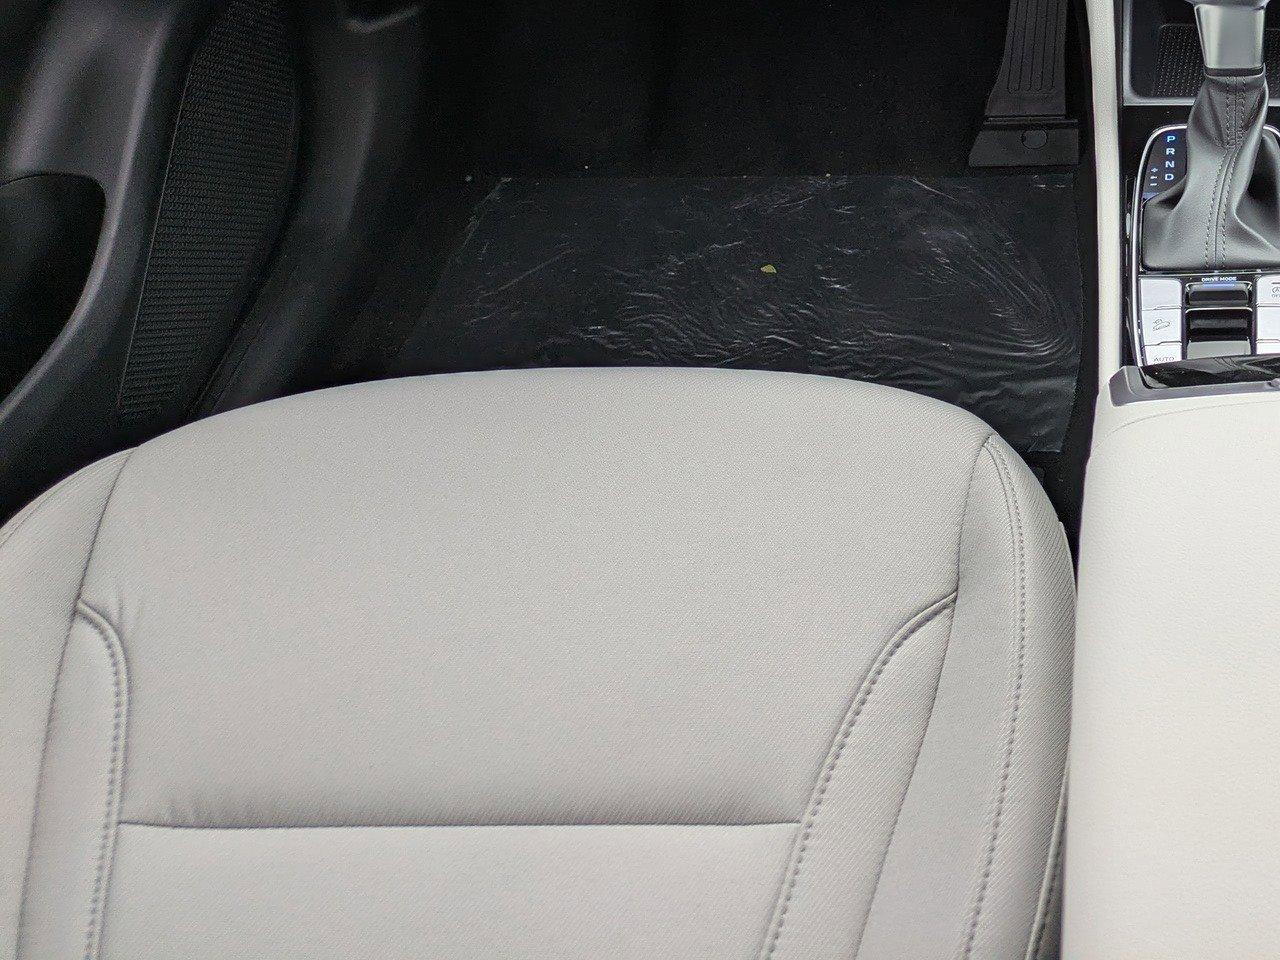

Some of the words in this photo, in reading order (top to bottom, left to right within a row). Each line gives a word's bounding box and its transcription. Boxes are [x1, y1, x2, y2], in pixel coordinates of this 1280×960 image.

[1166, 148, 1176, 156] R
[1165, 160, 1174, 168] N
[1164, 173, 1174, 181] D
